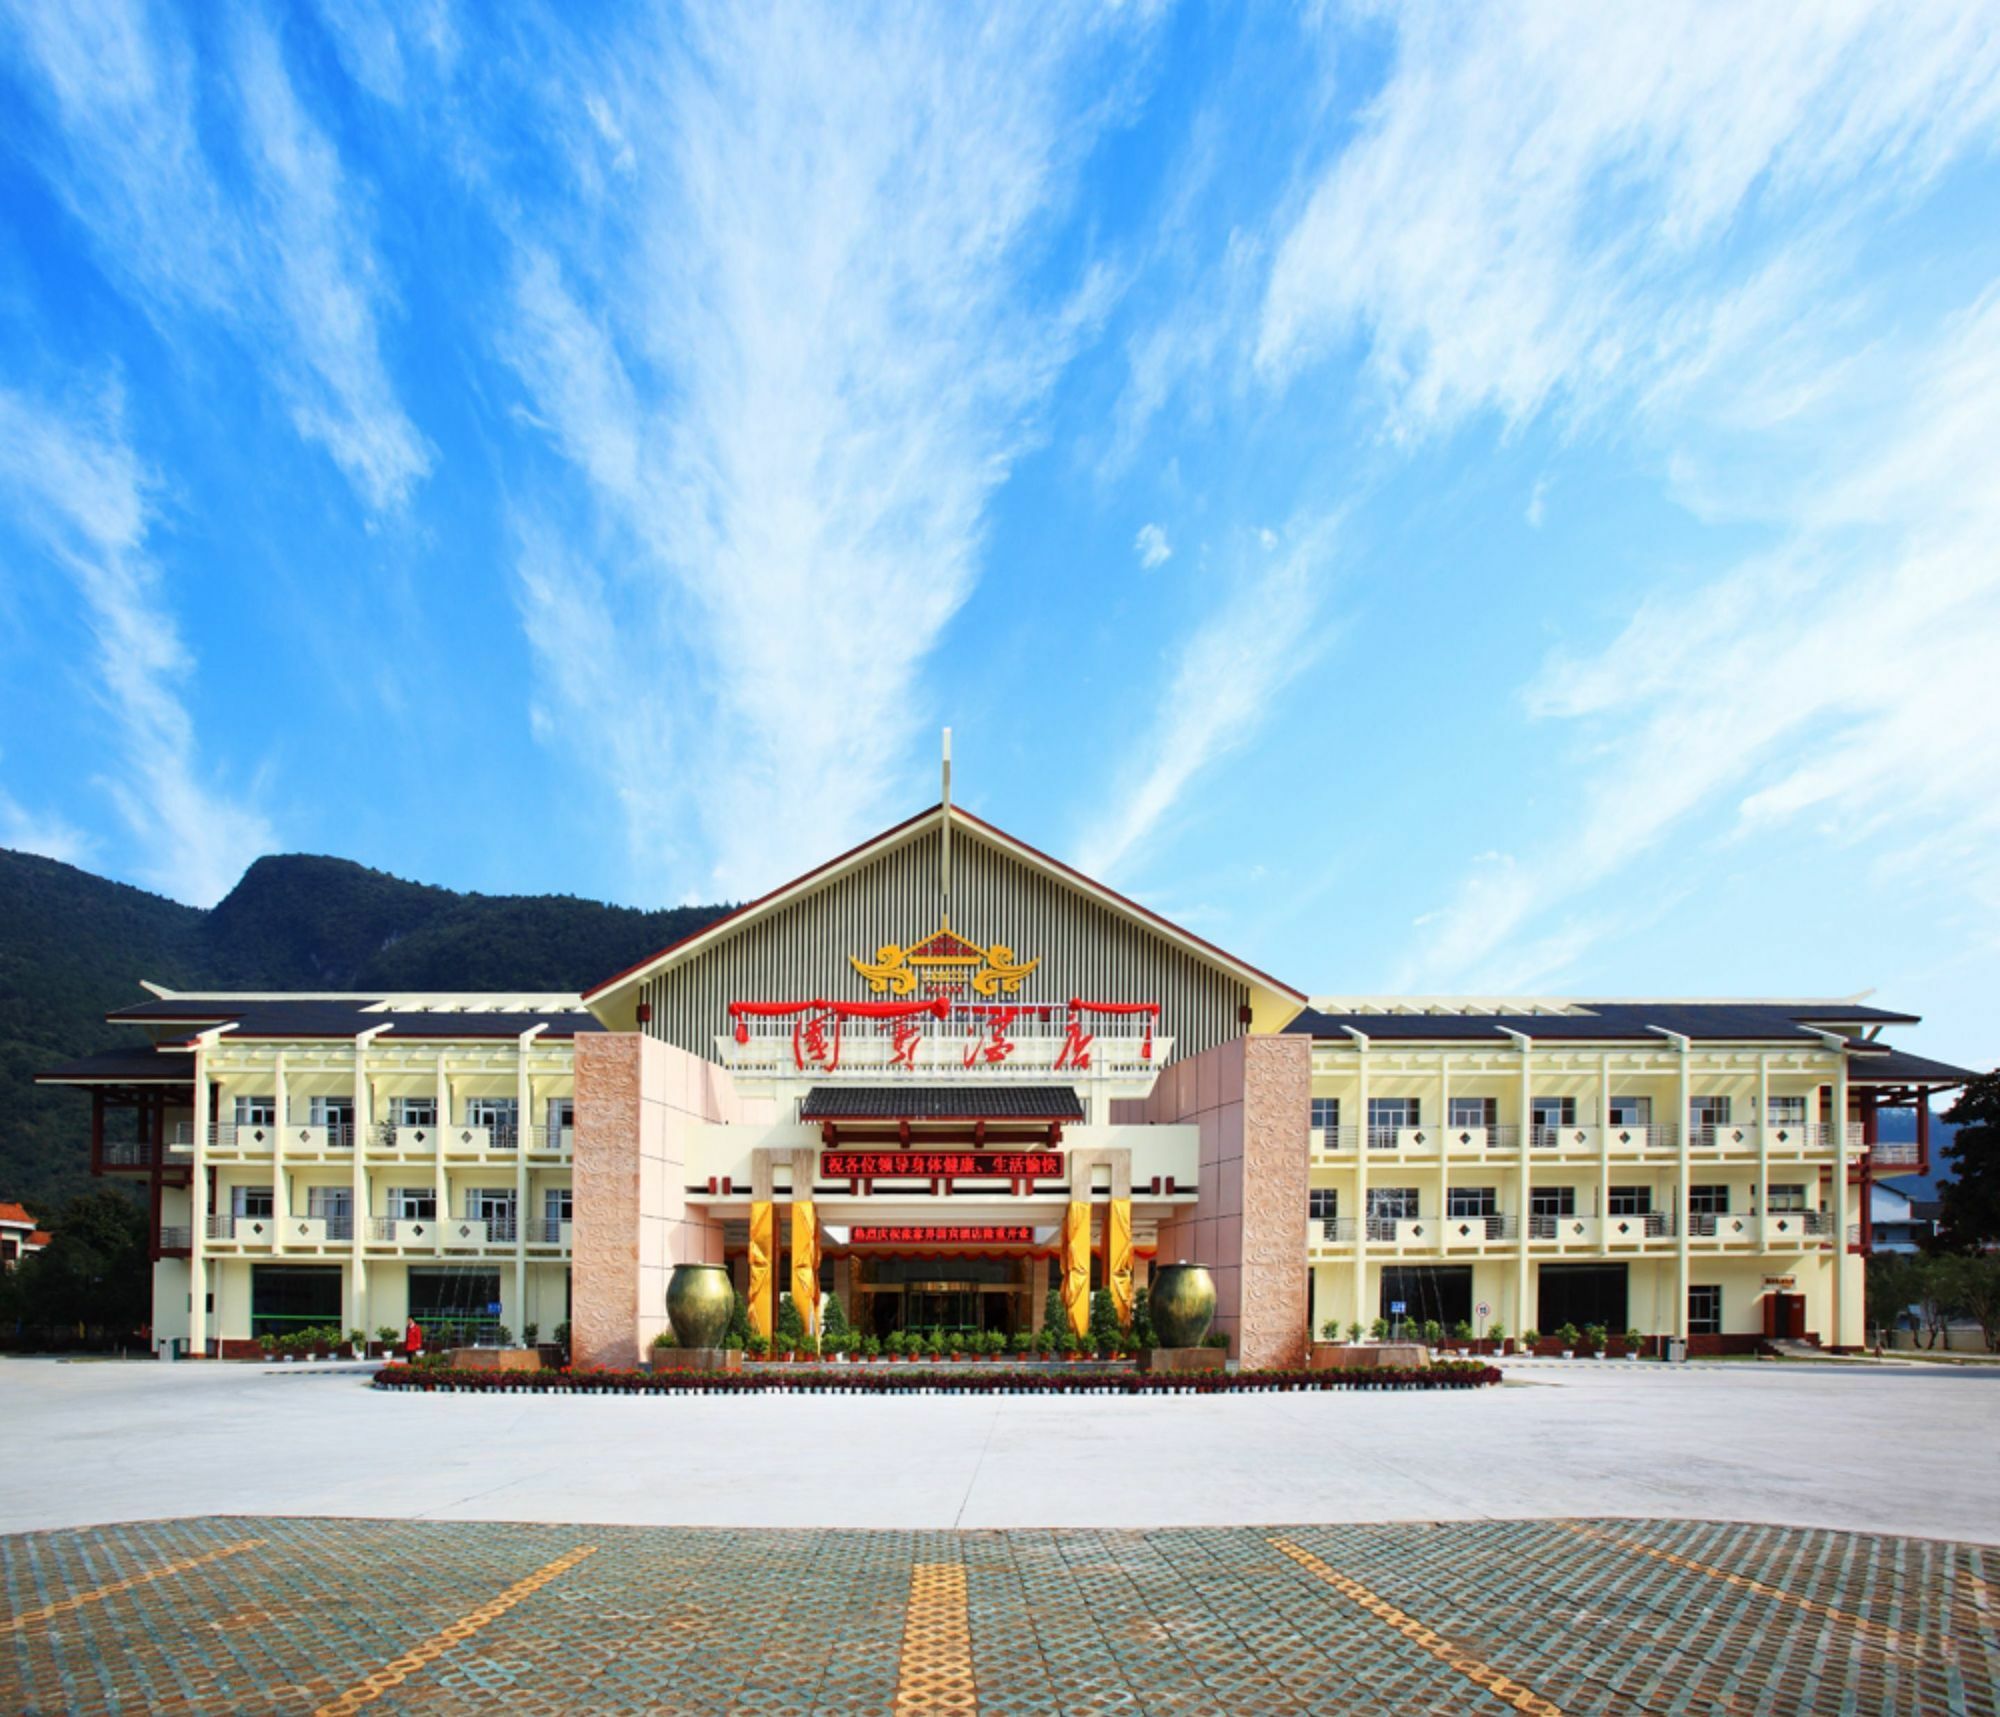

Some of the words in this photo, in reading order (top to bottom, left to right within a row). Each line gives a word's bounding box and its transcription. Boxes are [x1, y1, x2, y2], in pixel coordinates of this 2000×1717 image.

[828, 1156, 1057, 1173] 祝各位领导身体健康、生活愉快
